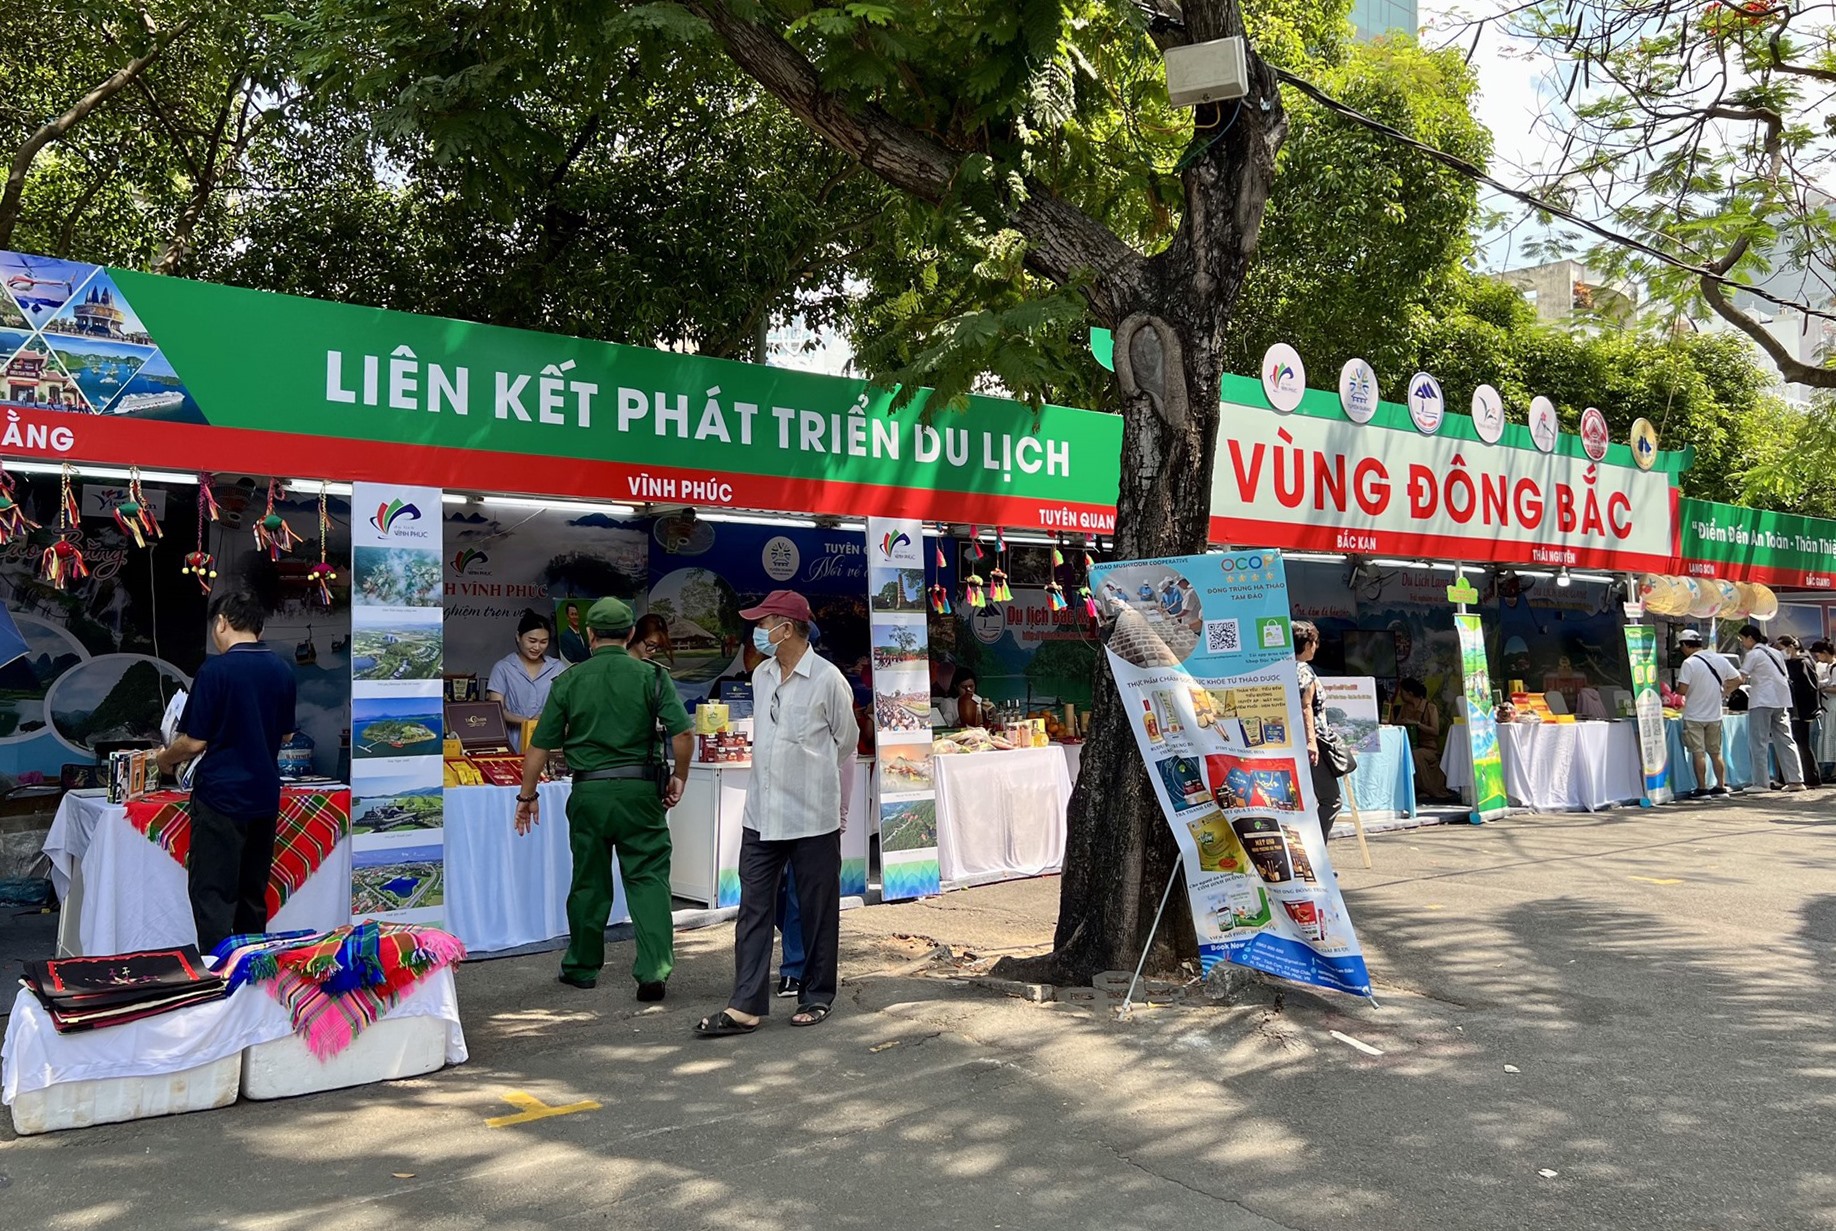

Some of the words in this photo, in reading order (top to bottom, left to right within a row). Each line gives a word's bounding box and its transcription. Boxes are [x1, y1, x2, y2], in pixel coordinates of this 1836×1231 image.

[326, 344, 468, 416] LIÊN
[495, 359, 598, 428] KẾT
[617, 385, 758, 445] PHÁT
[771, 394, 899, 460] TRIỂN
[915, 424, 968, 467] DU
[983, 432, 1069, 482] LỊCH
[628, 473, 676, 498] VĨNH
[681, 477, 733, 502] PHÚC
[1227, 426, 1391, 516] VÙNG
[1407, 453, 1543, 530] ĐÔNG
[1556, 462, 1633, 540] BẮC
[1039, 506, 1077, 527] TUYÊN
[1080, 512, 1115, 530] QUAN
[824, 541, 860, 555] TUYÊN
[1337, 529, 1356, 549] BẮC
[1358, 536, 1377, 553] KẠN
[1728, 524, 1748, 545] Đến
[1750, 530, 1765, 547] An
[1765, 531, 1789, 550] Toàn
[1795, 535, 1818, 553] Thân
[1149, 558, 1189, 567] COOPERATIVE
[1221, 556, 1275, 572] OCOP
[1532, 547, 1549, 563] THÁI
[1549, 549, 1576, 564] NGUYÊN
[461, 581, 502, 597] VĨNH
[506, 582, 548, 599] PHÚC
[443, 604, 477, 621] ghiệm
[1007, 606, 1023, 625] Du
[1026, 606, 1048, 629] lịch
[1210, 943, 1230, 952] Book
[1230, 941, 1246, 950] Now
